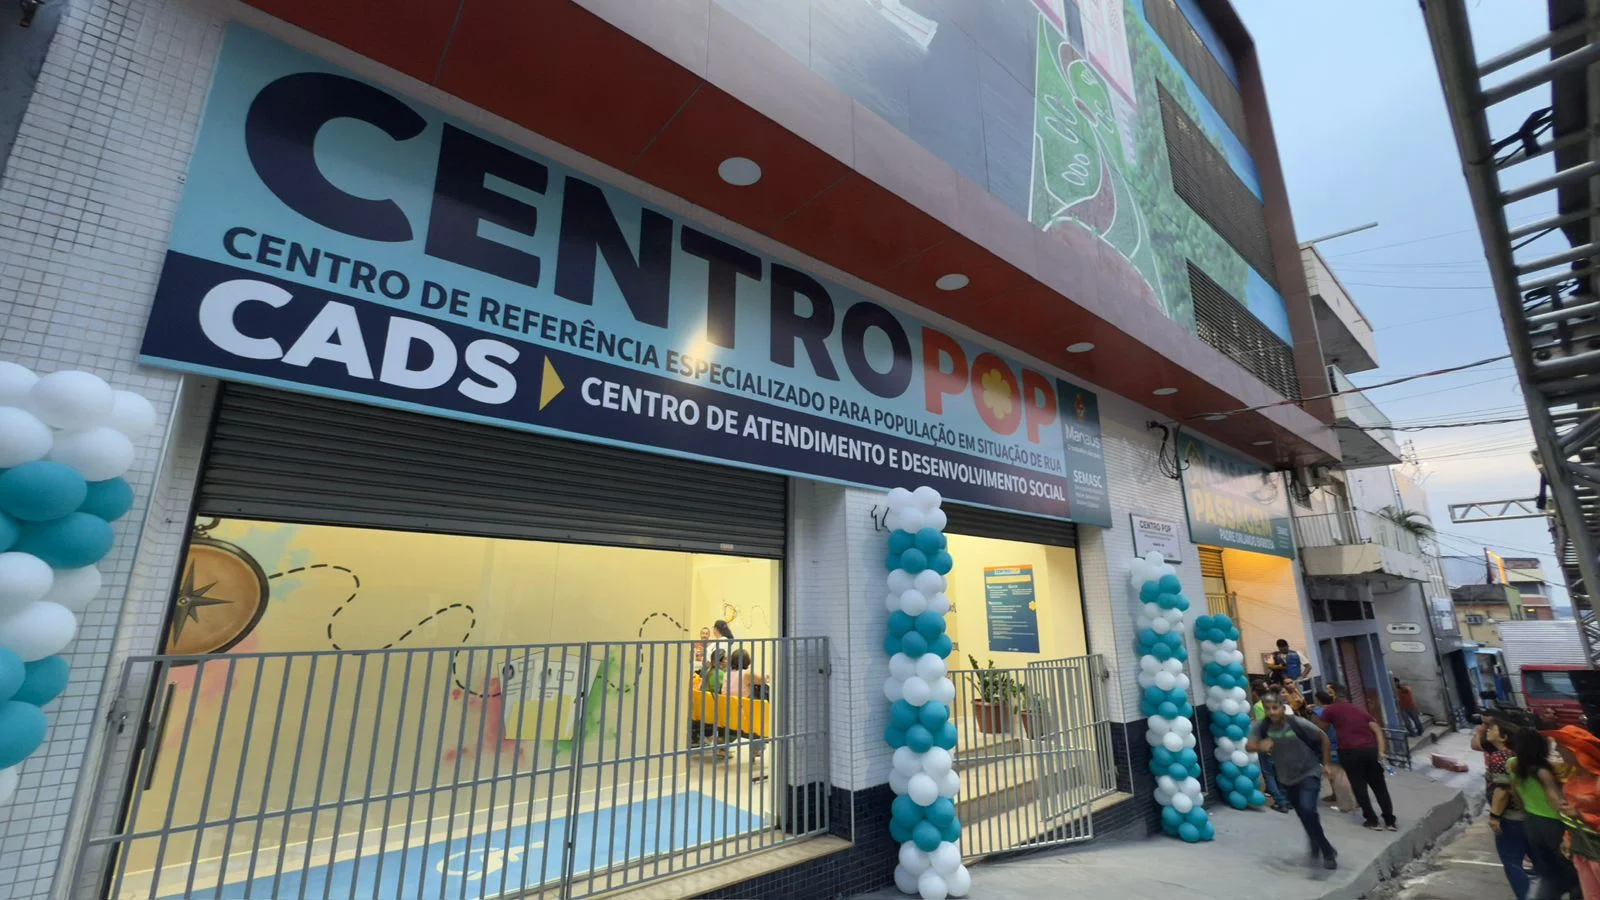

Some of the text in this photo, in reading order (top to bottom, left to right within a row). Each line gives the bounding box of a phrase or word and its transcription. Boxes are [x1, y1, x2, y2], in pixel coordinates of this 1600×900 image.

[244, 72, 1057, 444] CENTRO POP
[199, 278, 521, 405] CADS
[222, 226, 410, 300] CENTRO
[420, 279, 471, 318] DE
[478, 295, 660, 369] REFERÊNCIA
[665, 349, 826, 412] ESPECIALIZADO
[829, 396, 872, 425] PARA
[874, 408, 956, 447] POPULAÇÃO
[958, 433, 976, 451] EM
[977, 438, 1028, 465] SITUAÇÃO
[1031, 453, 1043, 468] DE
[1044, 456, 1063, 473] RUA
[580, 376, 701, 426] CENTRO
[706, 404, 739, 436] DE
[742, 414, 886, 466] ATENDIMENTO
[888, 447, 900, 469] E
[901, 450, 1028, 494] DESENVOLVIMENTO
[1030, 479, 1066, 502] SOCIAL
[1064, 423, 1101, 449] Manaus
[1073, 469, 1103, 489] SEMASC
